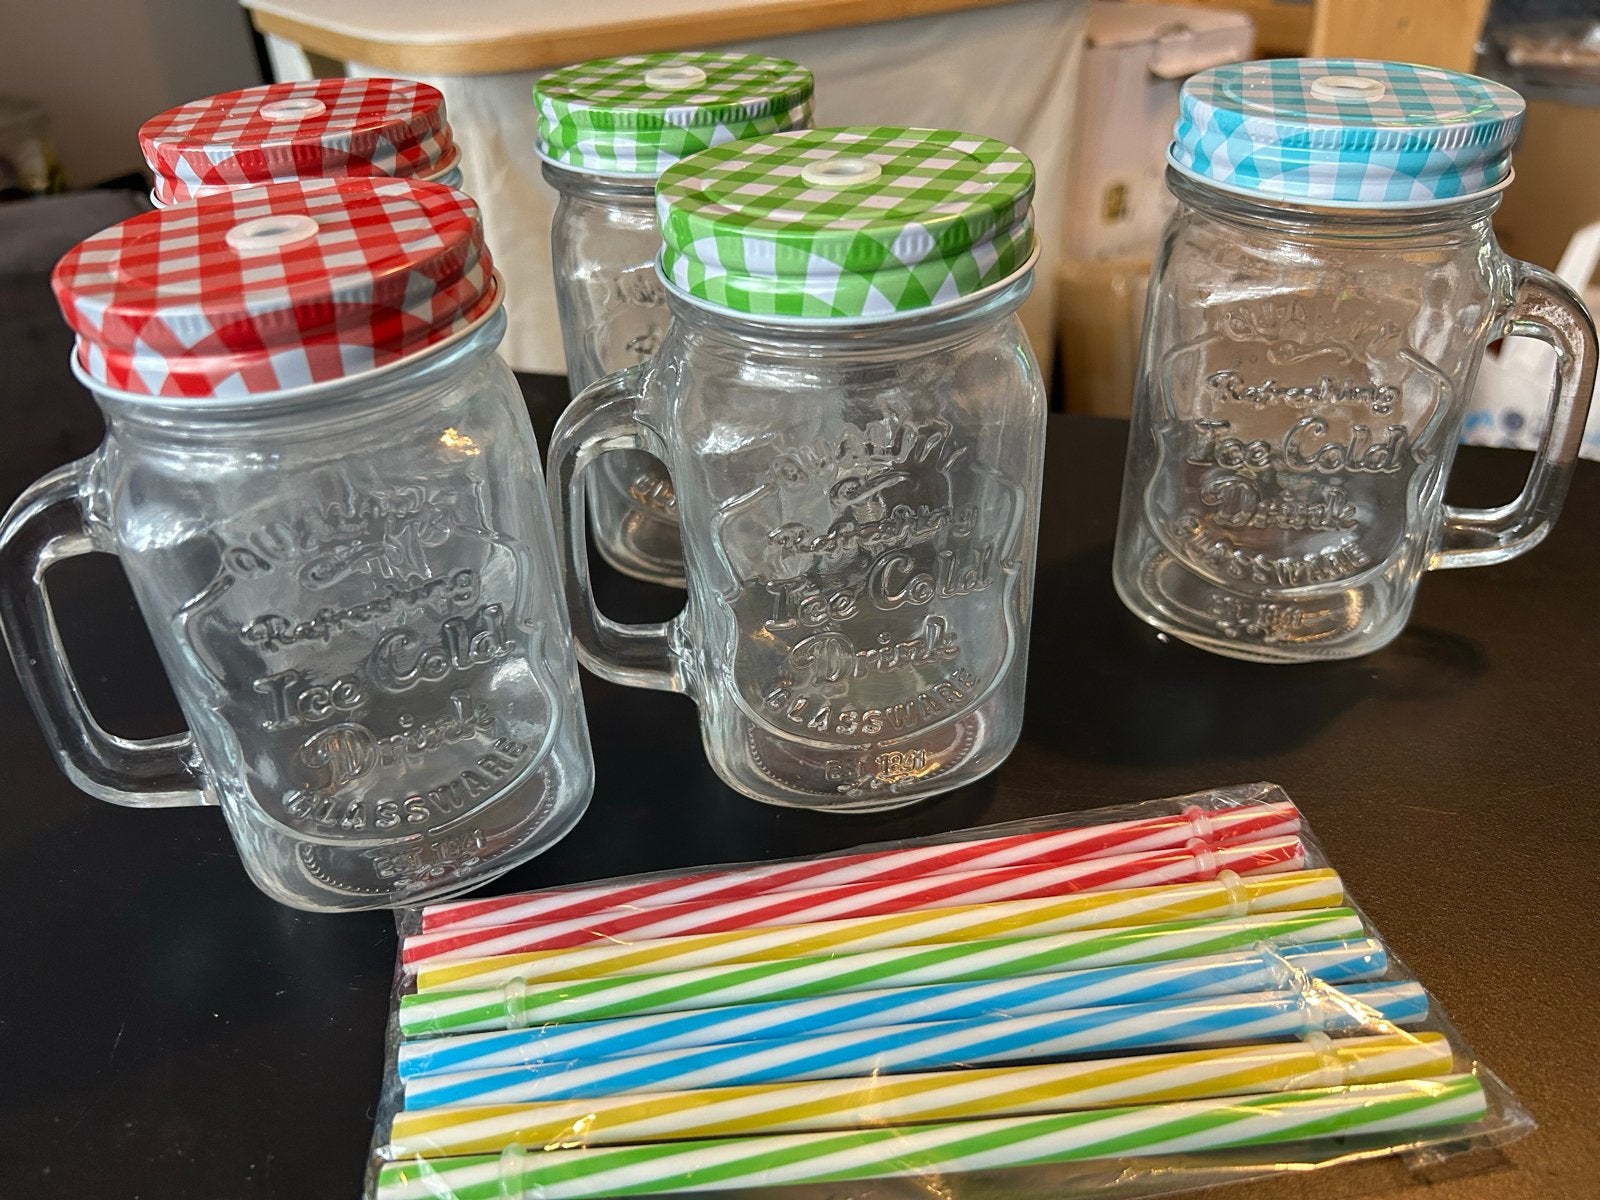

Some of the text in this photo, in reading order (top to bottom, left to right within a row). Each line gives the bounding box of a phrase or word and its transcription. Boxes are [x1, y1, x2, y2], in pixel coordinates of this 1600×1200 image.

[1283, 416, 1407, 474] Cold
[1200, 473, 1361, 531] Drink
[867, 537, 994, 611] Cold
[368, 602, 517, 691] Cold
[789, 612, 960, 684] Drink
[763, 667, 981, 736] GLASSWARE
[301, 690, 498, 787] Drink
[283, 736, 528, 831] GLASSWARE
